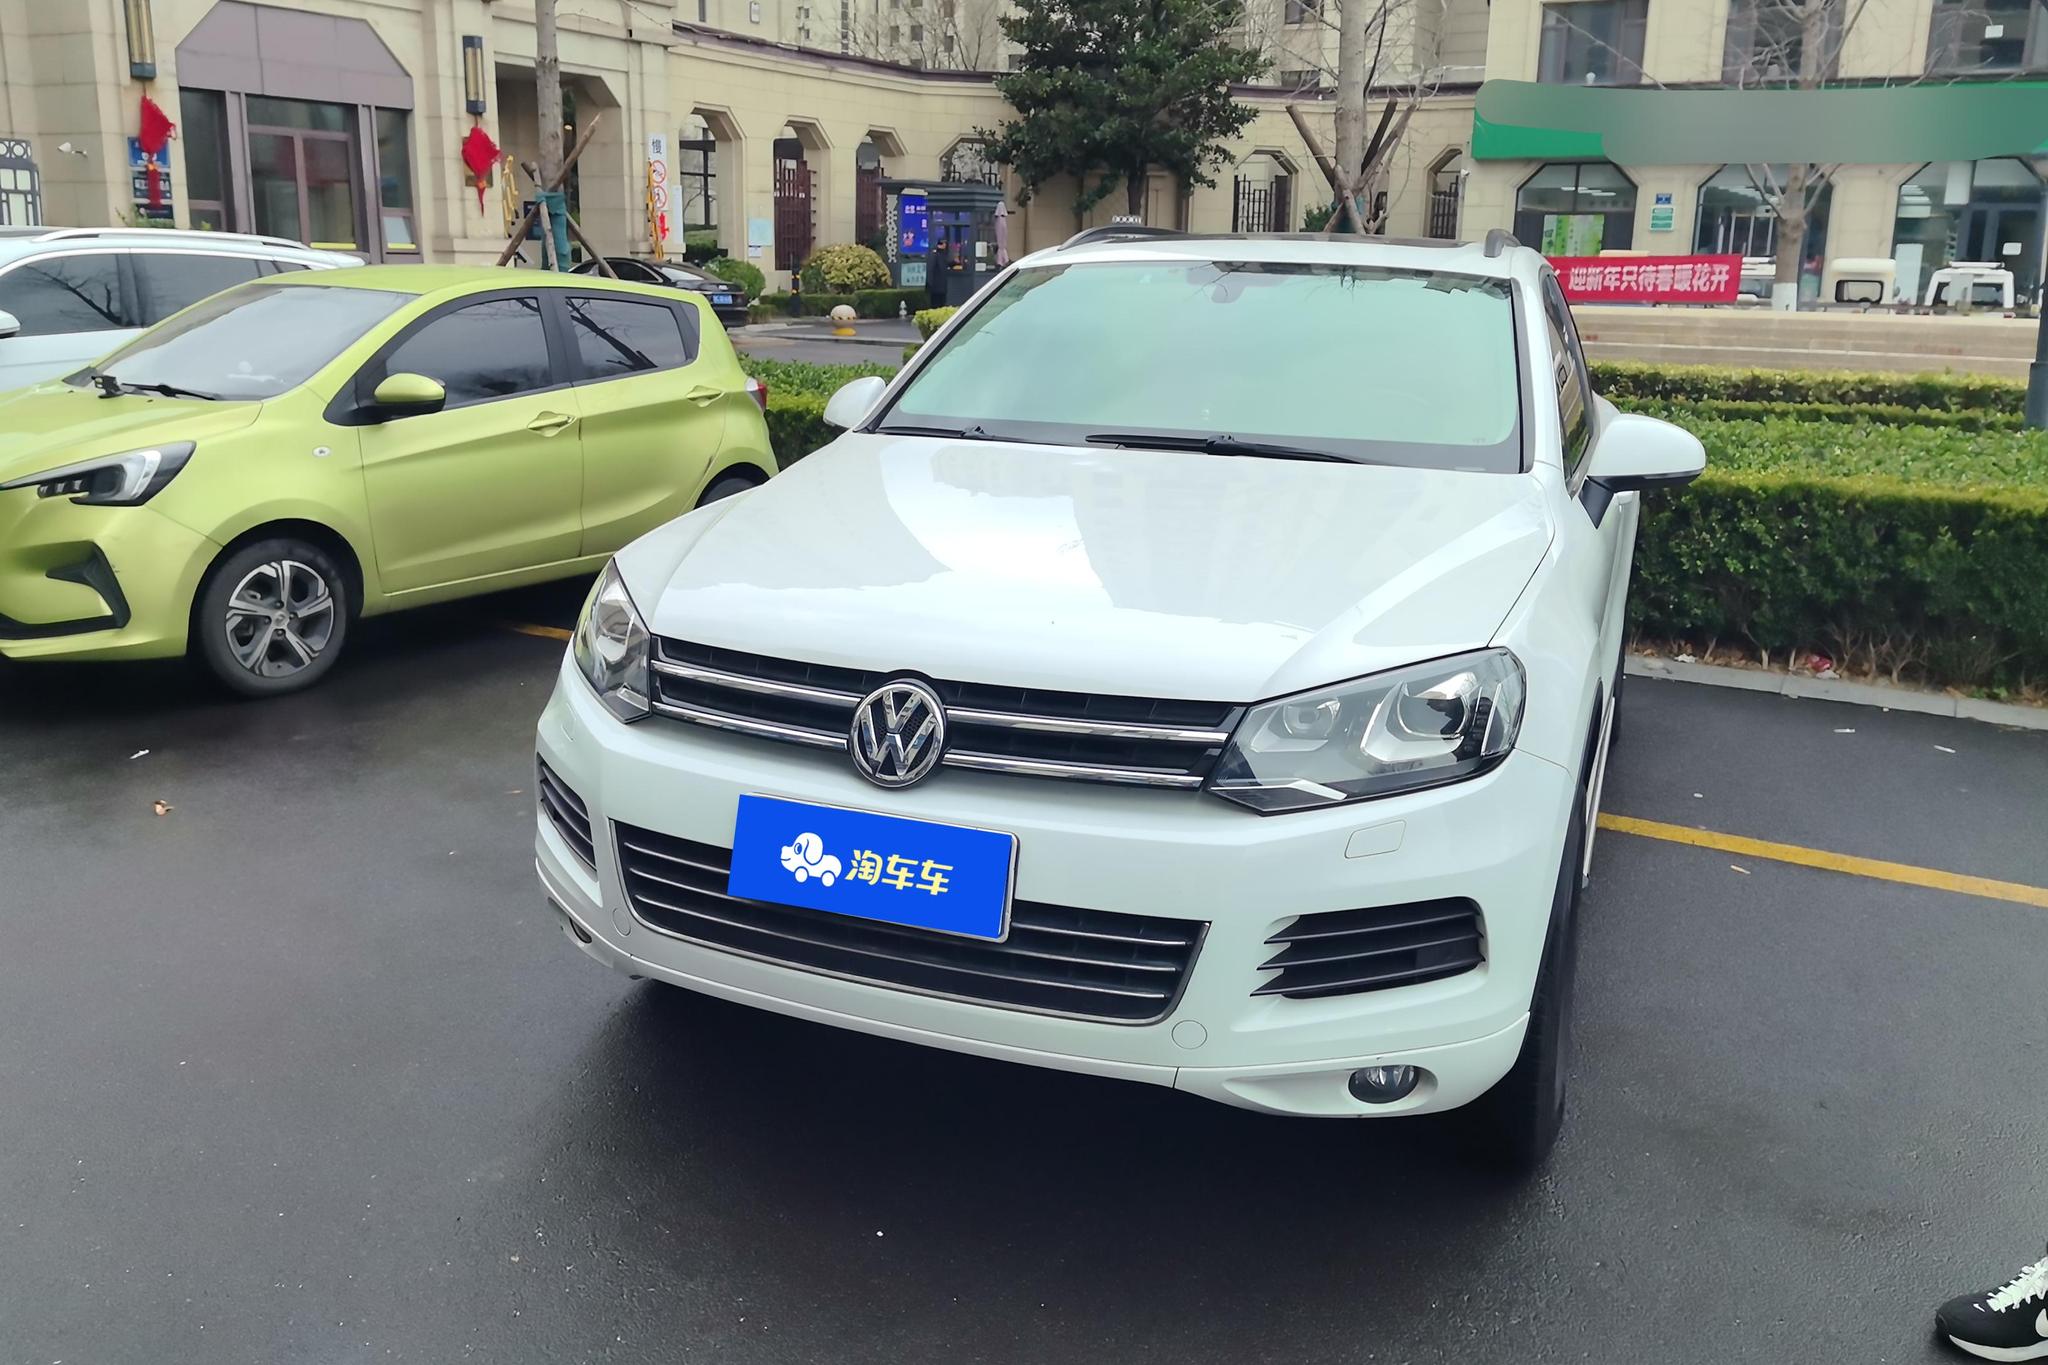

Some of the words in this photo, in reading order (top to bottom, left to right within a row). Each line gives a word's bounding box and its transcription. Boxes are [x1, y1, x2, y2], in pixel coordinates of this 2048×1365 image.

[1568, 263, 1731, 292] 迎新年只待春暖花开
[856, 686, 940, 782] VW
